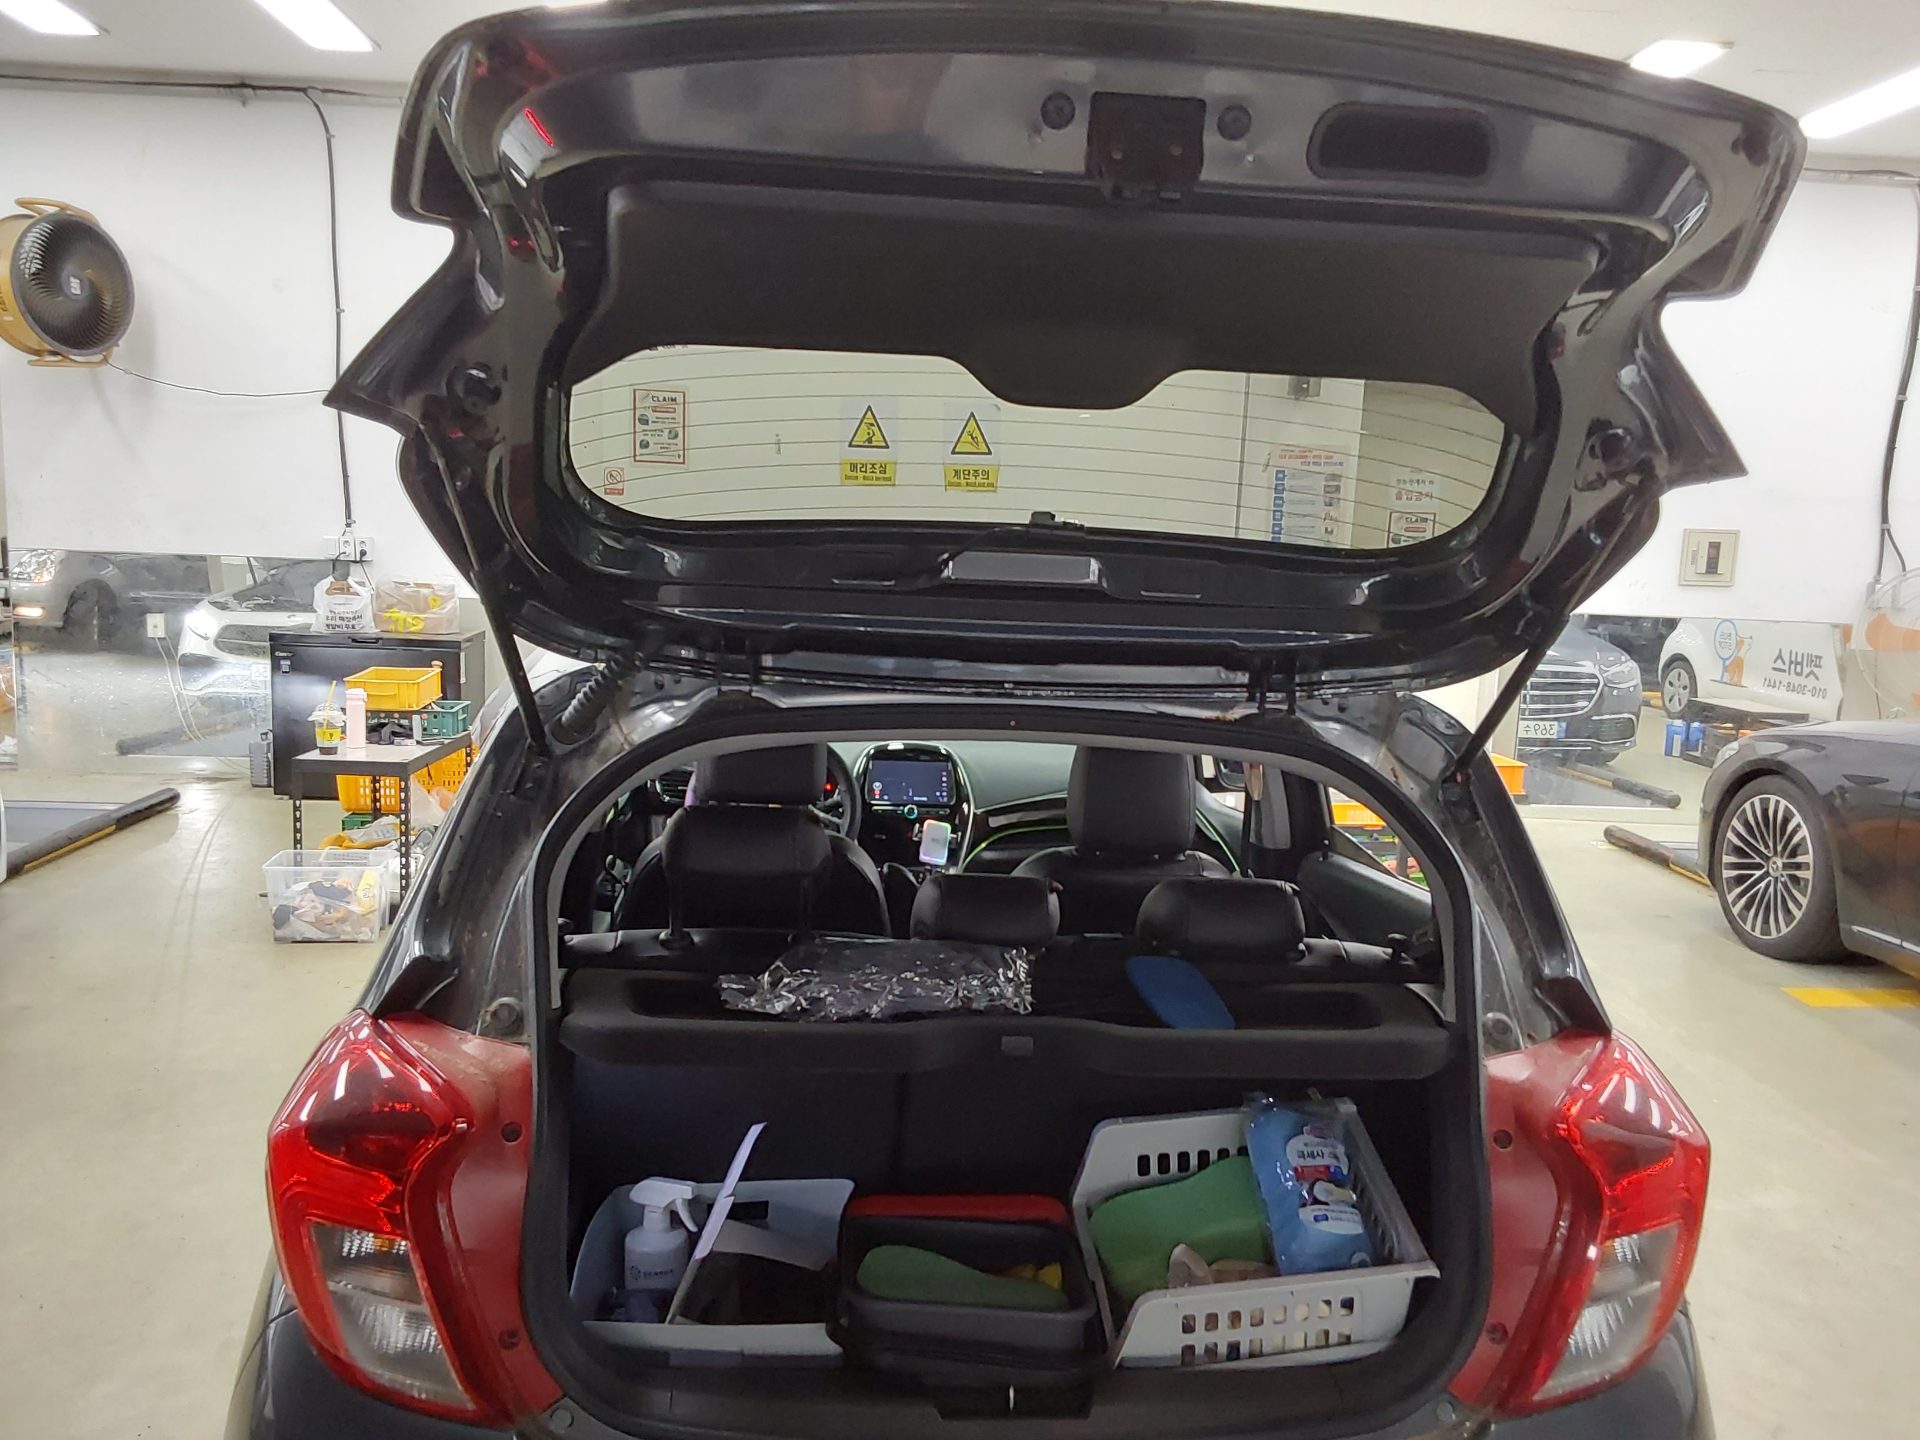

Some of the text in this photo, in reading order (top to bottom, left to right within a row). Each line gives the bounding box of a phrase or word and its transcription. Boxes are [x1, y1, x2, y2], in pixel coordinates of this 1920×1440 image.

[69, 277, 81, 294] CAT
[849, 463, 887, 474] 머리조심
[952, 469, 990, 481] 계단주의
